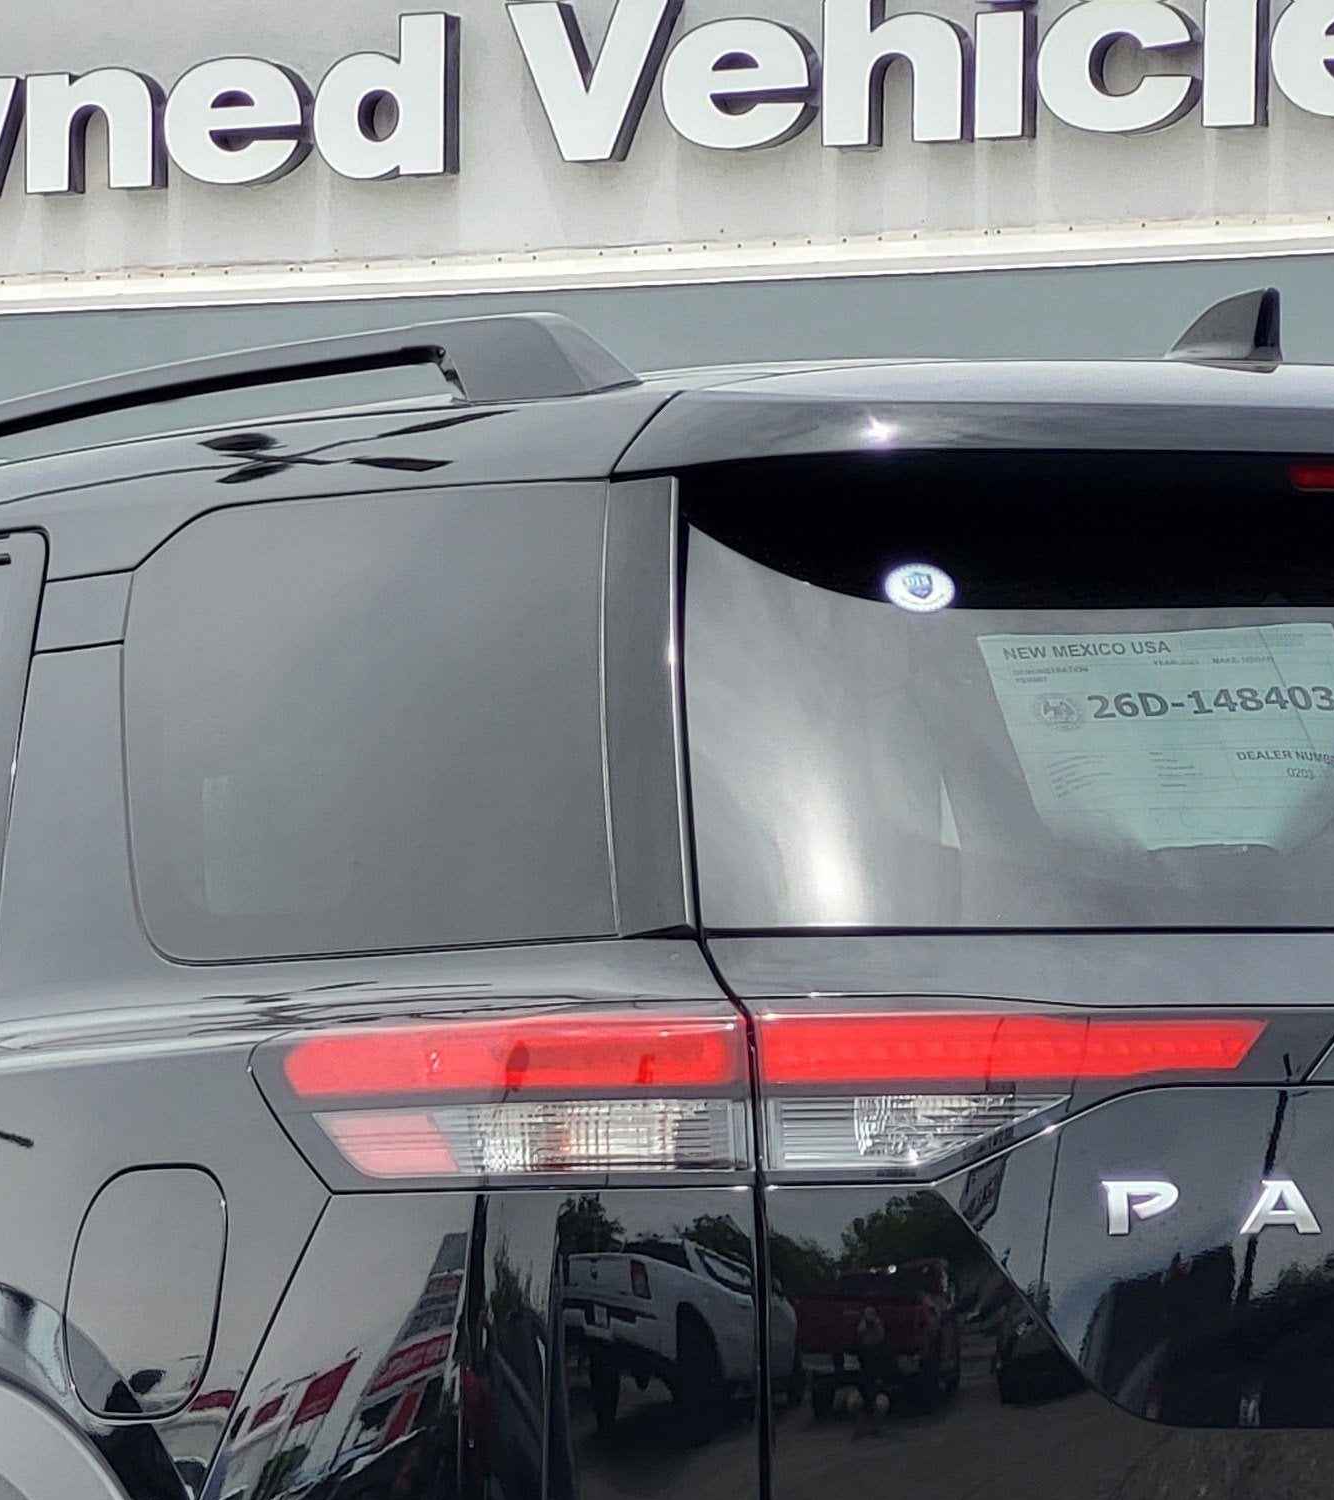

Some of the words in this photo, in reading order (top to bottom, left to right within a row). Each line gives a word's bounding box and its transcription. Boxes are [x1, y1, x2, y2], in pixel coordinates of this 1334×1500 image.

[1003, 646, 1046, 661] NEW
[1053, 642, 1126, 658] MEXICO
[1130, 640, 1171, 655] USA
[1236, 750, 1293, 761] DEALER
